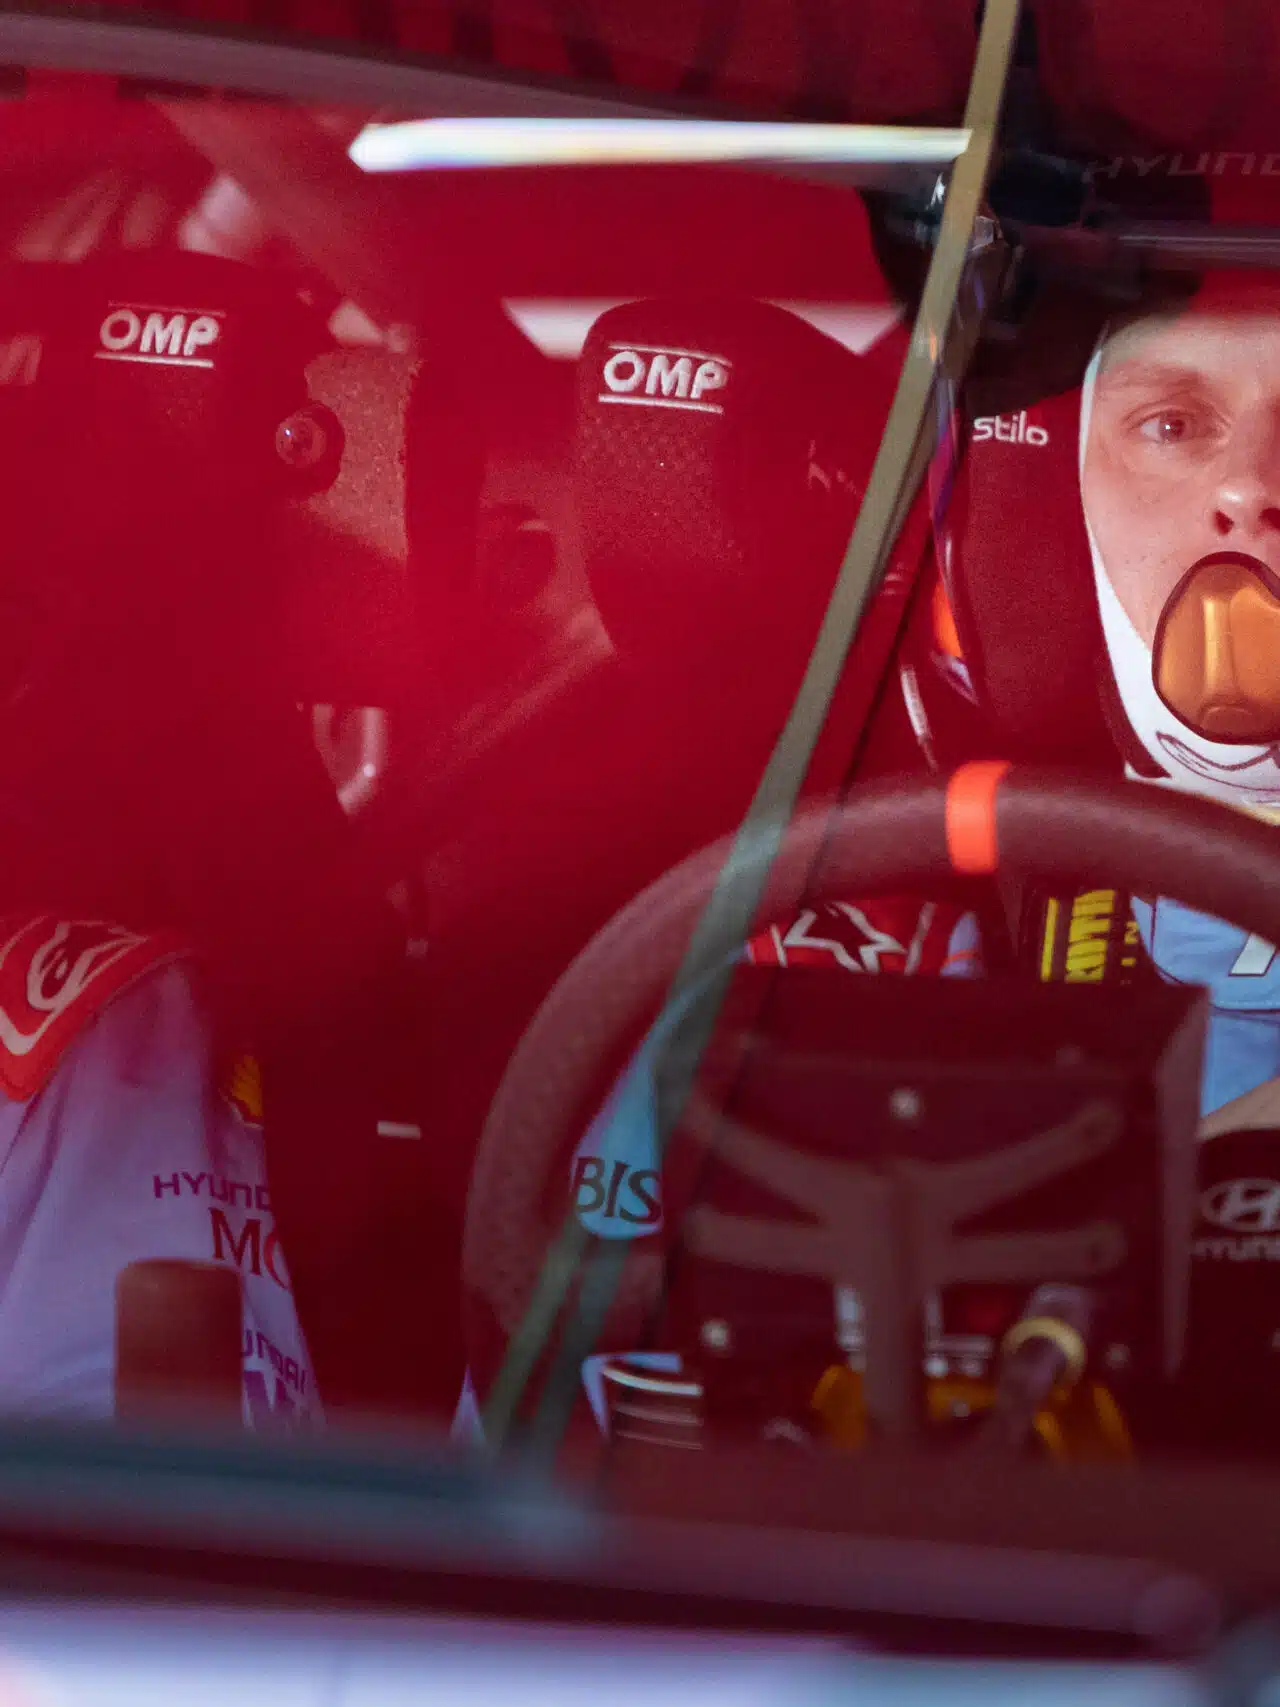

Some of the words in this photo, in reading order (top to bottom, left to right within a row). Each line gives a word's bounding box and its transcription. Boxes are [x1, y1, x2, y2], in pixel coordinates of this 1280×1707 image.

[99, 308, 220, 356] OMP
[602, 350, 729, 401] OMP
[972, 411, 1049, 447] stilo
[574, 1155, 662, 1224] BIS
